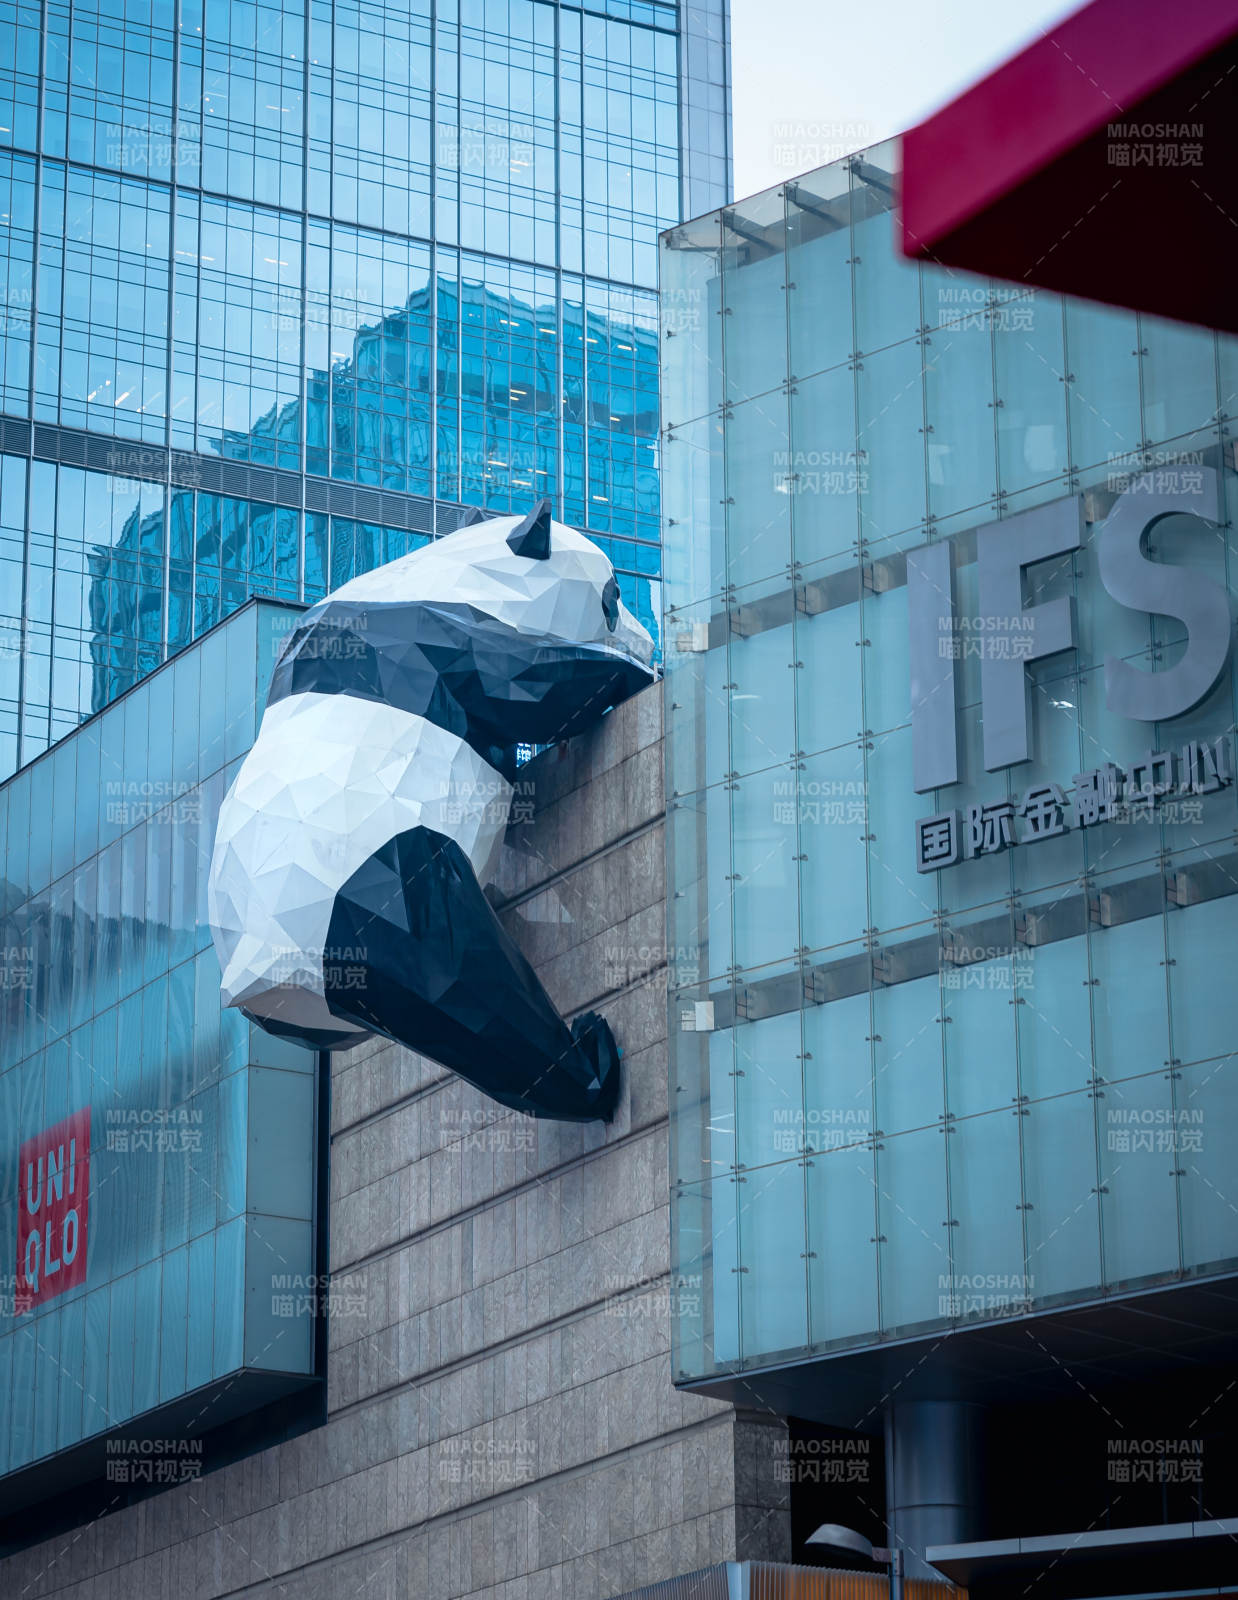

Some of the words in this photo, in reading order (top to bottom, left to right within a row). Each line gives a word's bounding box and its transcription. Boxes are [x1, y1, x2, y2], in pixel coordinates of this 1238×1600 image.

[907, 465, 1231, 794] IFS
[917, 737, 1233, 874] 国际金融中心
[27, 1138, 75, 1215] UNI
[25, 1209, 78, 1293] QLO
